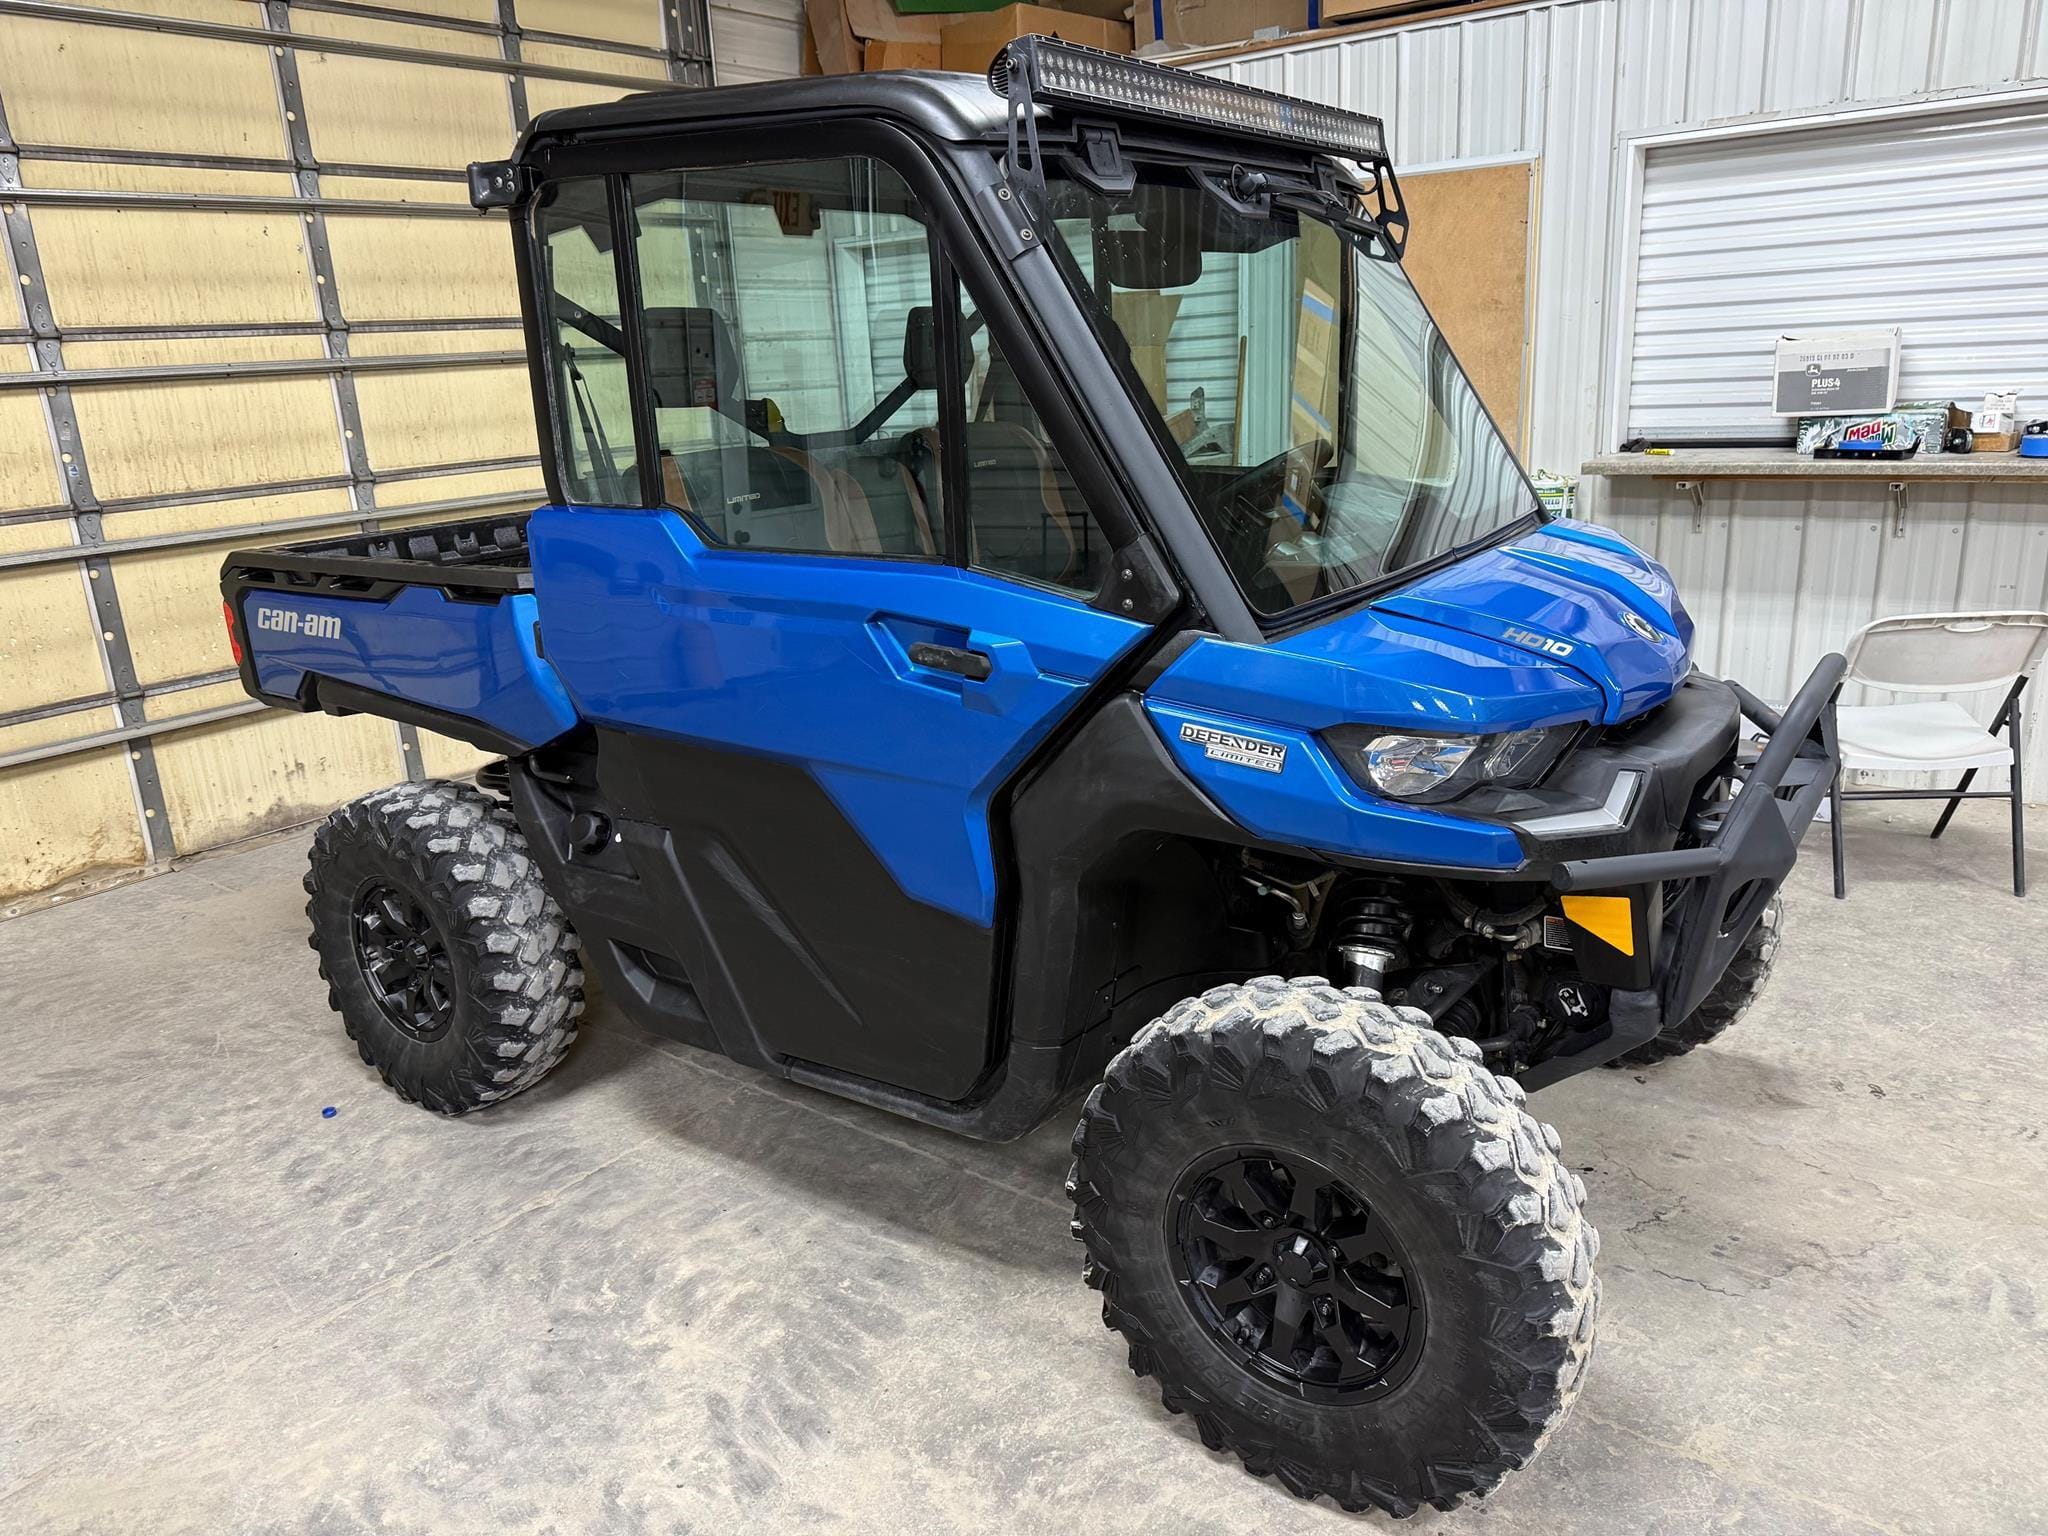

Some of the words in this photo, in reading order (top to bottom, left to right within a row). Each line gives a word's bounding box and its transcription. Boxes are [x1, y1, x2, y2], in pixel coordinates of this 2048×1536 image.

[257, 607, 342, 640] can-am
[1502, 627, 1575, 657] HD10
[1181, 725, 1285, 758] DEFENDER
[1209, 748, 1277, 770] LIMITED
